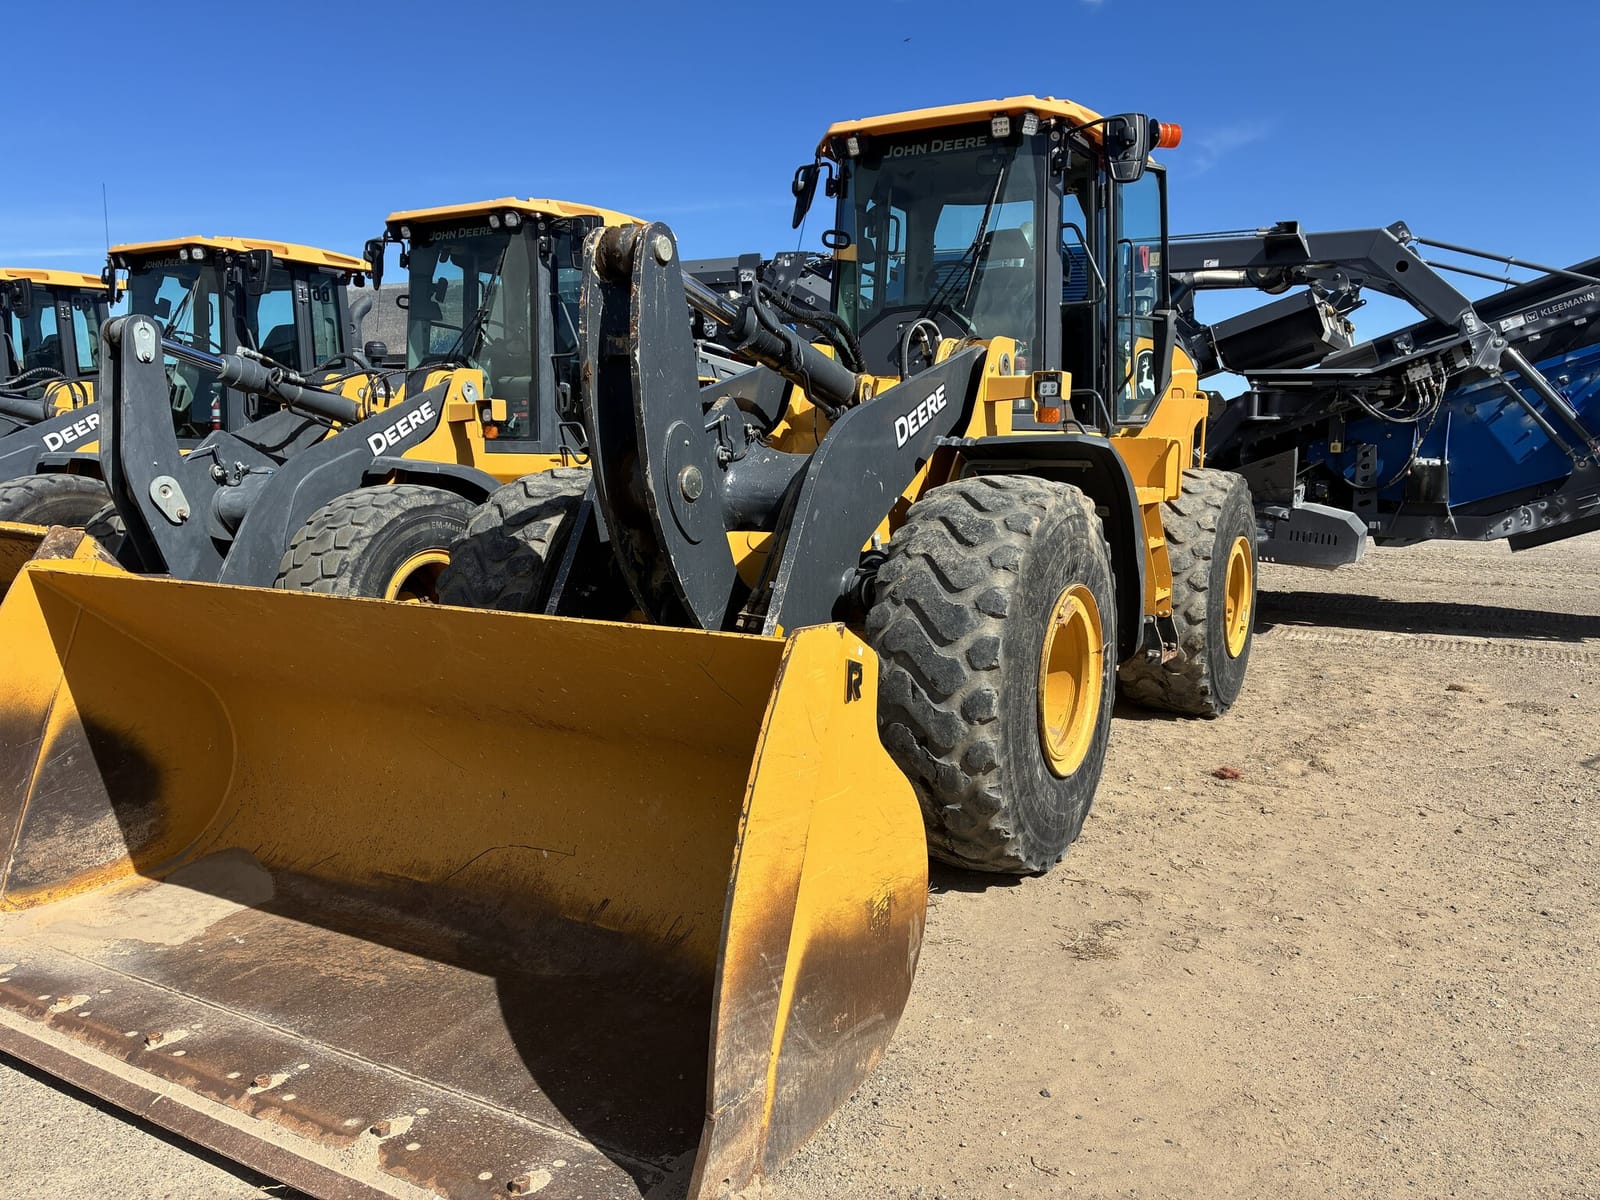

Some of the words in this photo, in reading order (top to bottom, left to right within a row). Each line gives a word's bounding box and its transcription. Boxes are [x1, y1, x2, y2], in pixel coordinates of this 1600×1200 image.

[883, 144, 928, 159] JOHN
[931, 135, 988, 153] DEERE
[428, 230, 457, 241] JOHN
[458, 226, 494, 239] DEERE
[1540, 292, 1596, 317] KLEEMANN
[42, 413, 100, 452] DEER
[366, 400, 437, 457] DEERE
[893, 383, 948, 449] DEERE
[844, 658, 864, 704] R
